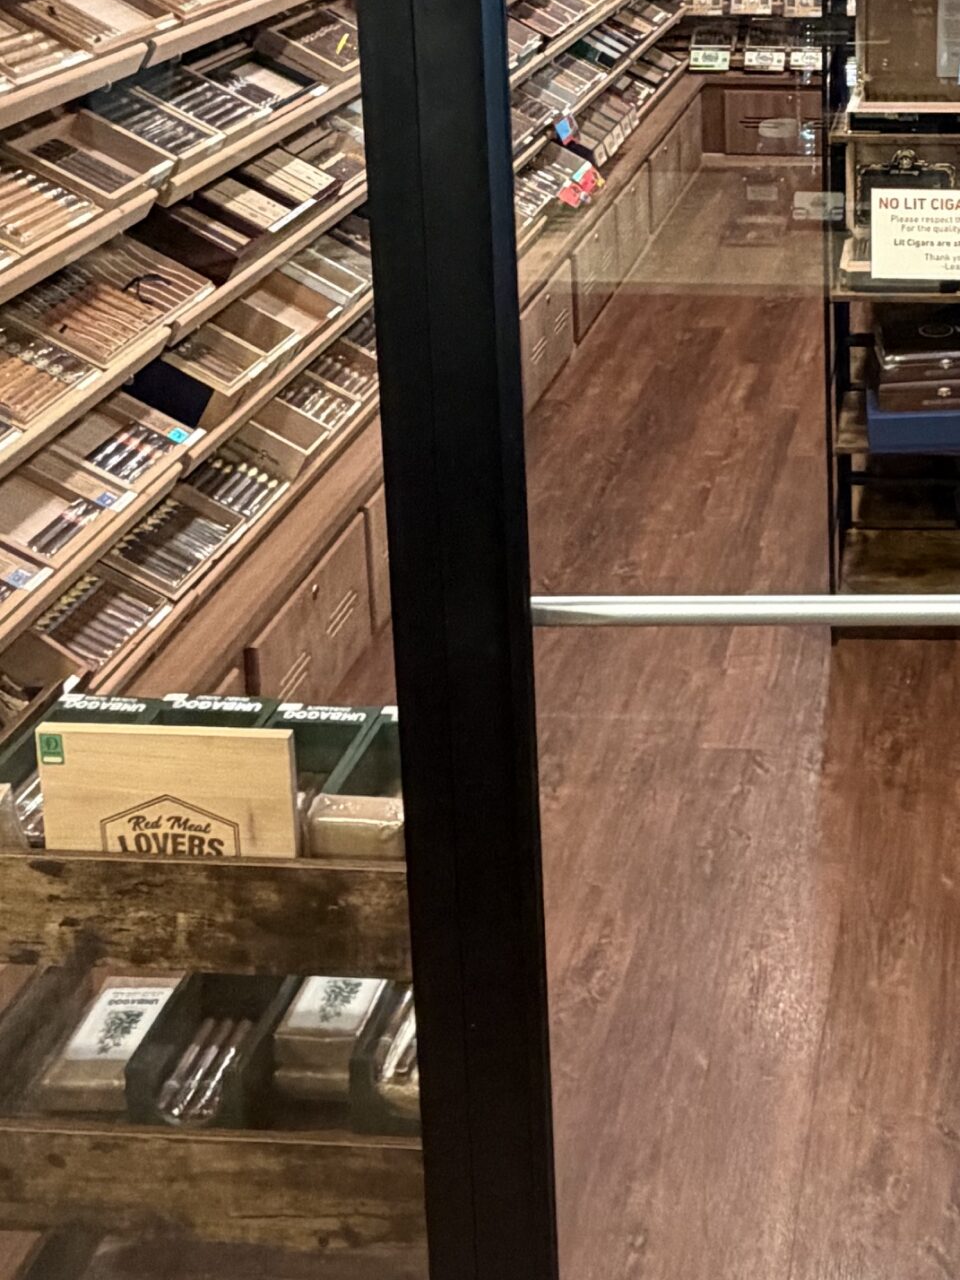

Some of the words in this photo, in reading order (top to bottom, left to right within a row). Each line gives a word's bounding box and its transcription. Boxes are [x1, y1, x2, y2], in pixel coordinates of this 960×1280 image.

[879, 197, 900, 210] NO
[904, 198, 927, 211] LIT
[890, 215, 919, 223] Please
[921, 216, 953, 225] respect
[901, 224, 915, 232] For
[907, 239, 935, 247] Cigars
[127, 815, 162, 831] Red
[166, 815, 211, 834] Meat
[117, 832, 224, 856] LOVERS
